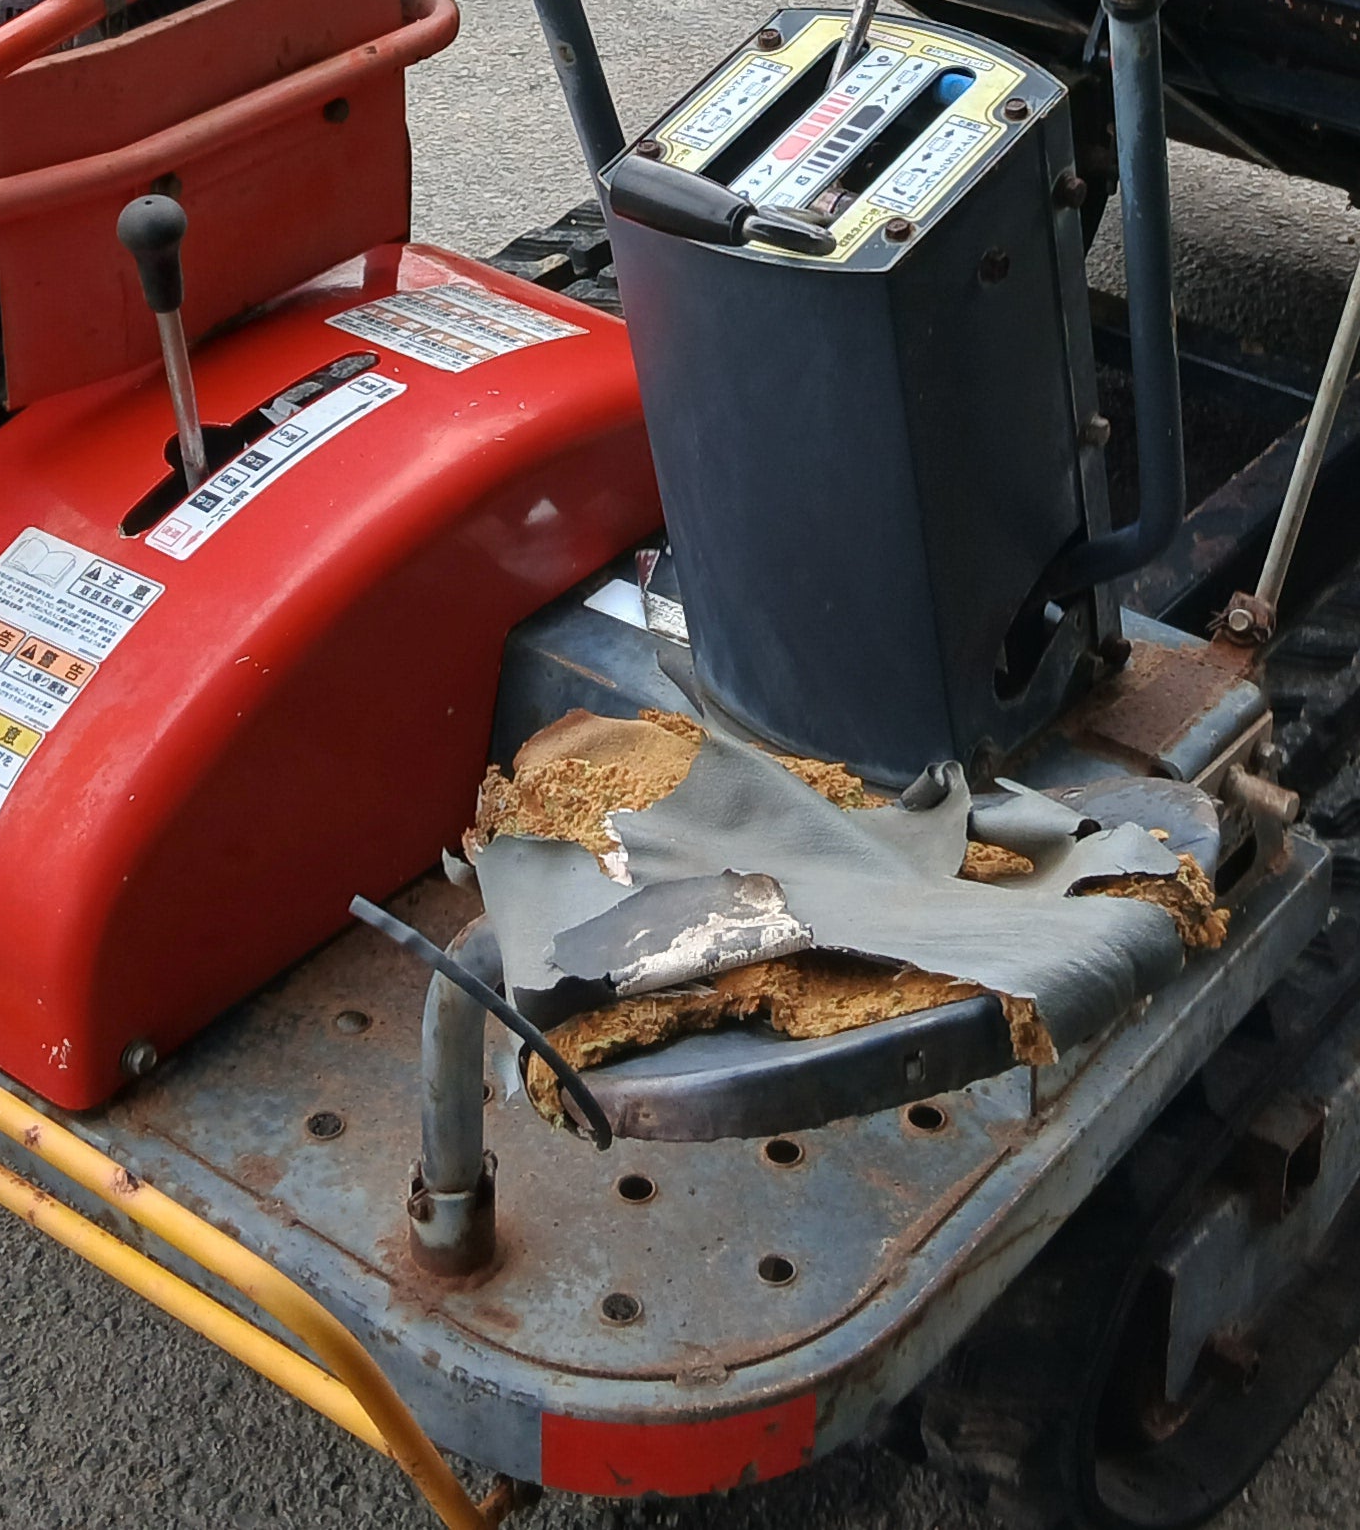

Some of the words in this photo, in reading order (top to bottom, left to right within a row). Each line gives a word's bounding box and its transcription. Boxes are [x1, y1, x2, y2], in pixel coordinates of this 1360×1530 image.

[243, 454, 266, 469] 中立
[195, 495, 216, 509] 中立
[79, 584, 135, 616] 取扱説明書
[102, 571, 151, 601] 注意
[38, 649, 86, 681] 警告
